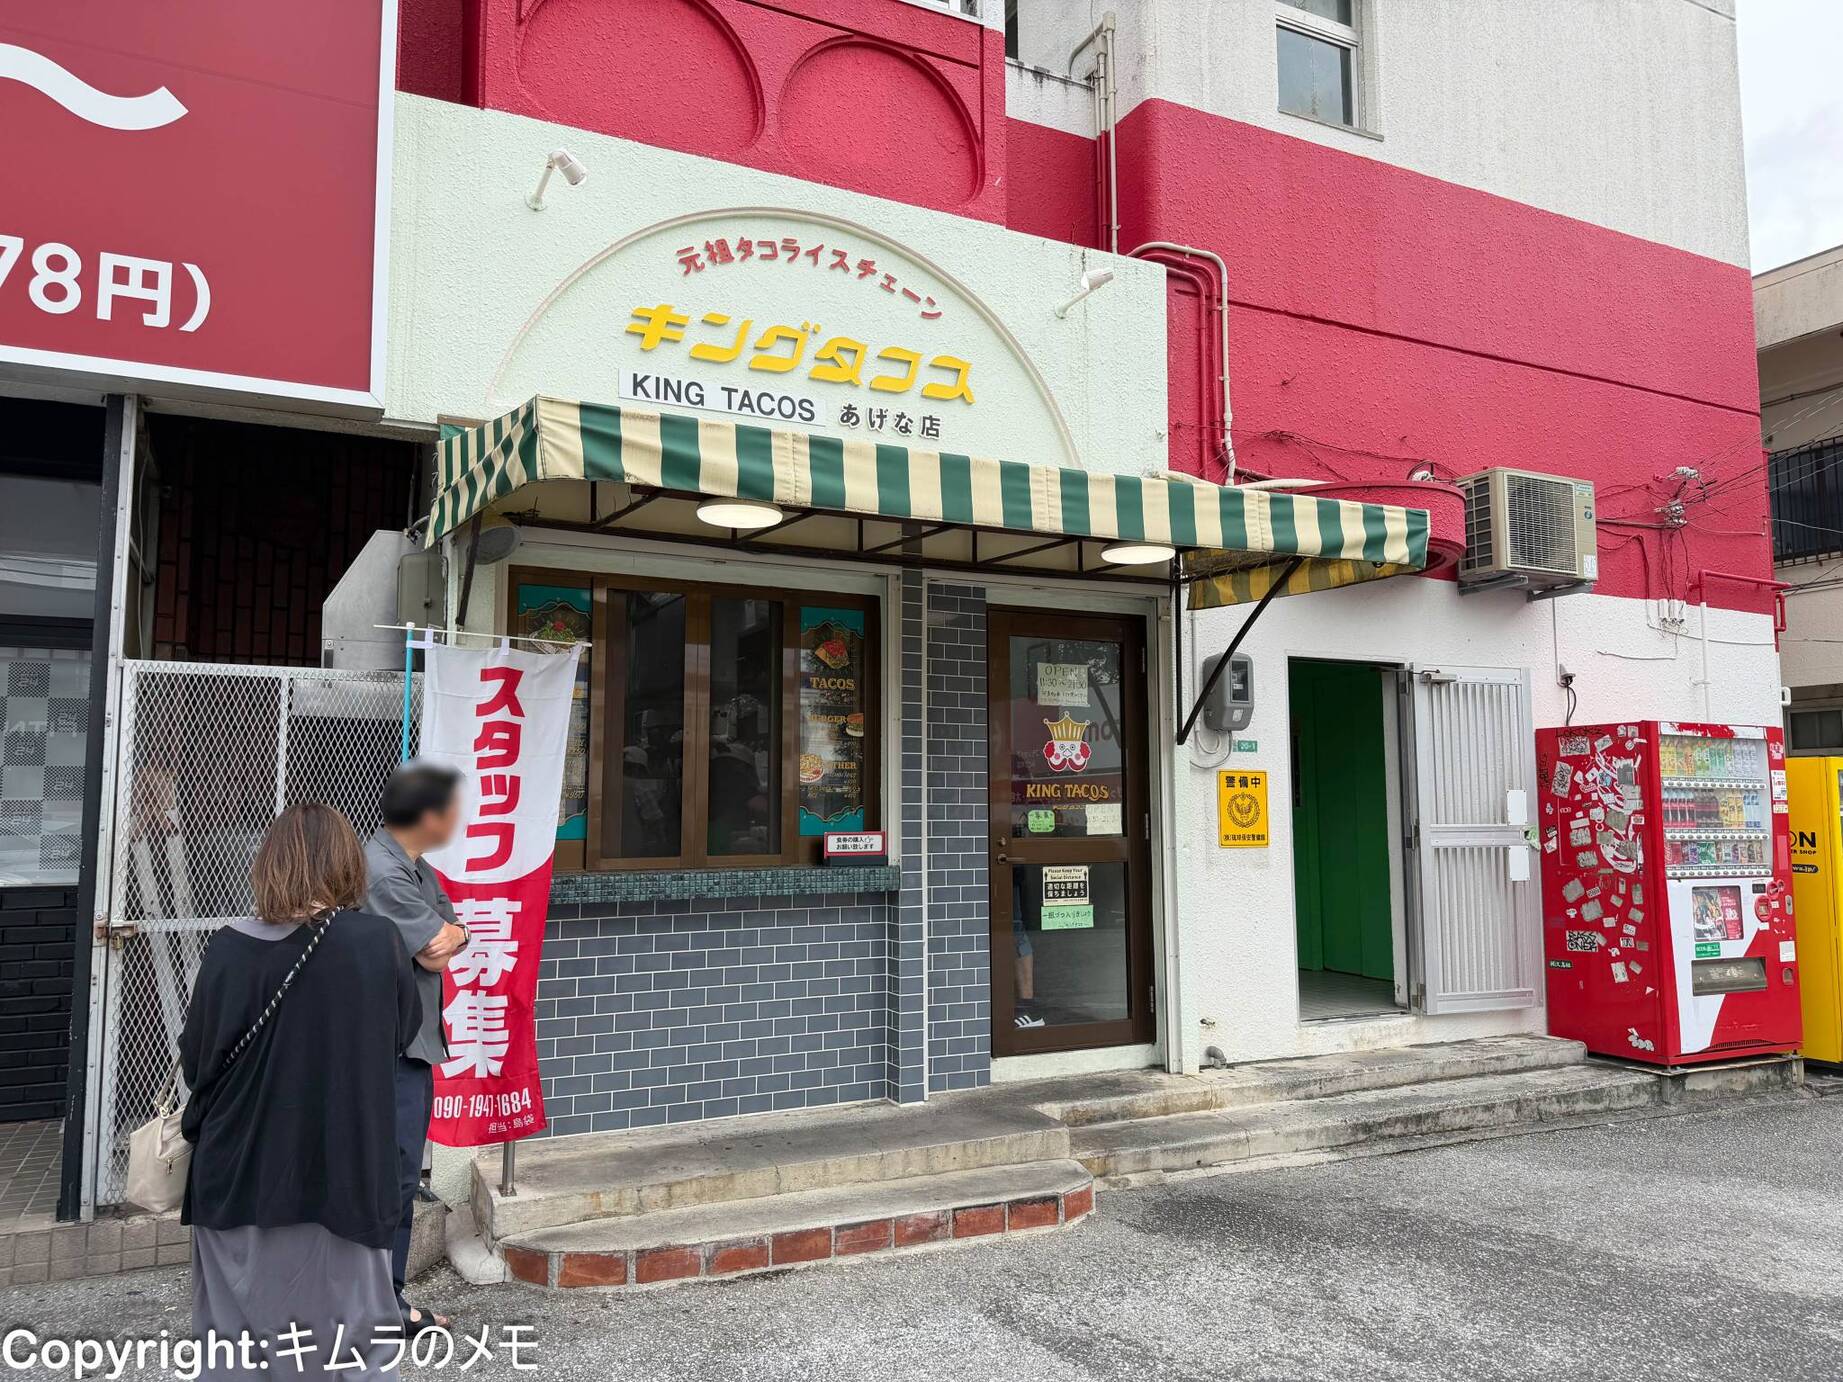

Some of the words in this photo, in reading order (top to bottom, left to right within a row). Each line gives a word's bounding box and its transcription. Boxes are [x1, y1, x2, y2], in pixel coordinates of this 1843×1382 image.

[676, 236, 943, 320] 元祖タコライスチェーン
[625, 304, 977, 405] キングタコス
[631, 373, 706, 407] KING
[721, 386, 816, 422] TACOS
[839, 403, 942, 438] あげな店
[809, 677, 856, 691] TACOS
[1026, 783, 1062, 799] KING
[1064, 784, 1110, 802] TACOS
[1225, 776, 1261, 788] 警備中
[1046, 890, 1085, 898] 保ちましょう
